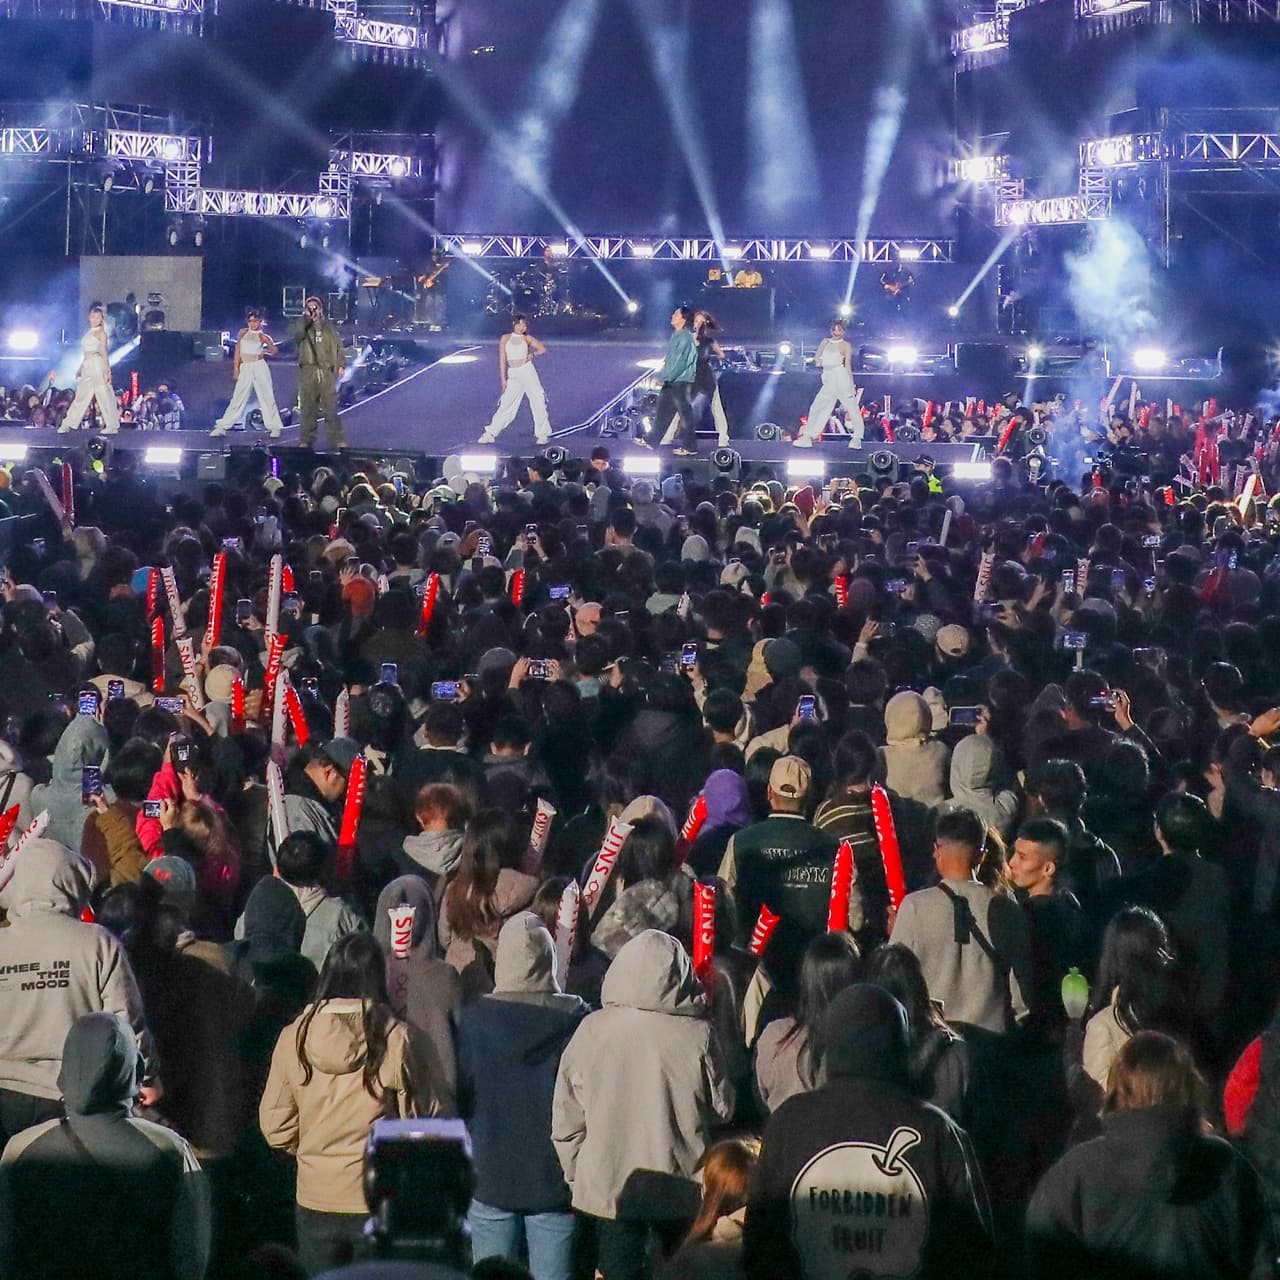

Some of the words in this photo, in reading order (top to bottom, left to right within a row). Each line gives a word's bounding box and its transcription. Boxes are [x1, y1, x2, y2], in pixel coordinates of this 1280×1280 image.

[37, 970, 70, 980] THE
[21, 980, 70, 992] MOOD
[809, 1186, 913, 1218] FORBIDDEN
